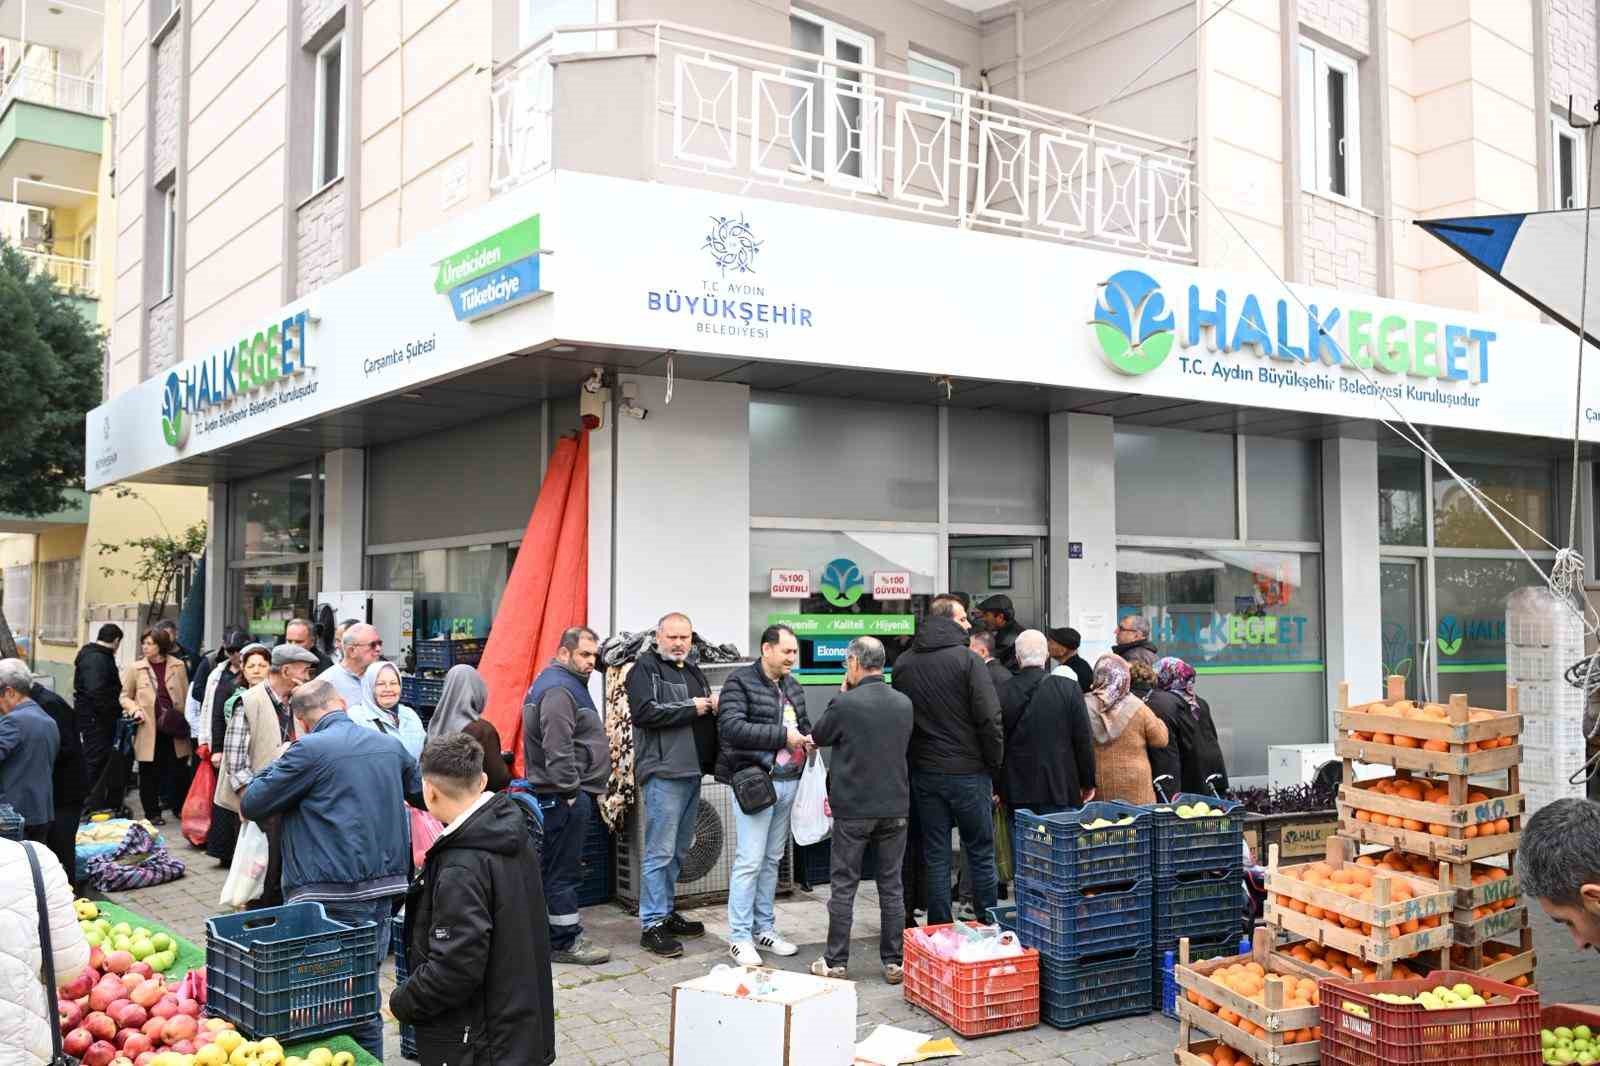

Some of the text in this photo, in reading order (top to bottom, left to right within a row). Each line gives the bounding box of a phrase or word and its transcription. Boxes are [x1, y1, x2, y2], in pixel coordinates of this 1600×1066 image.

[461, 274, 520, 311] Tüketiciye
[647, 289, 813, 327] BÜYÜKŞEHİR
[406, 332, 436, 364] Şubesi
[1179, 357, 1480, 408] T.C. Aydın Büyükşehir Belediyesi Kuruluşudur
